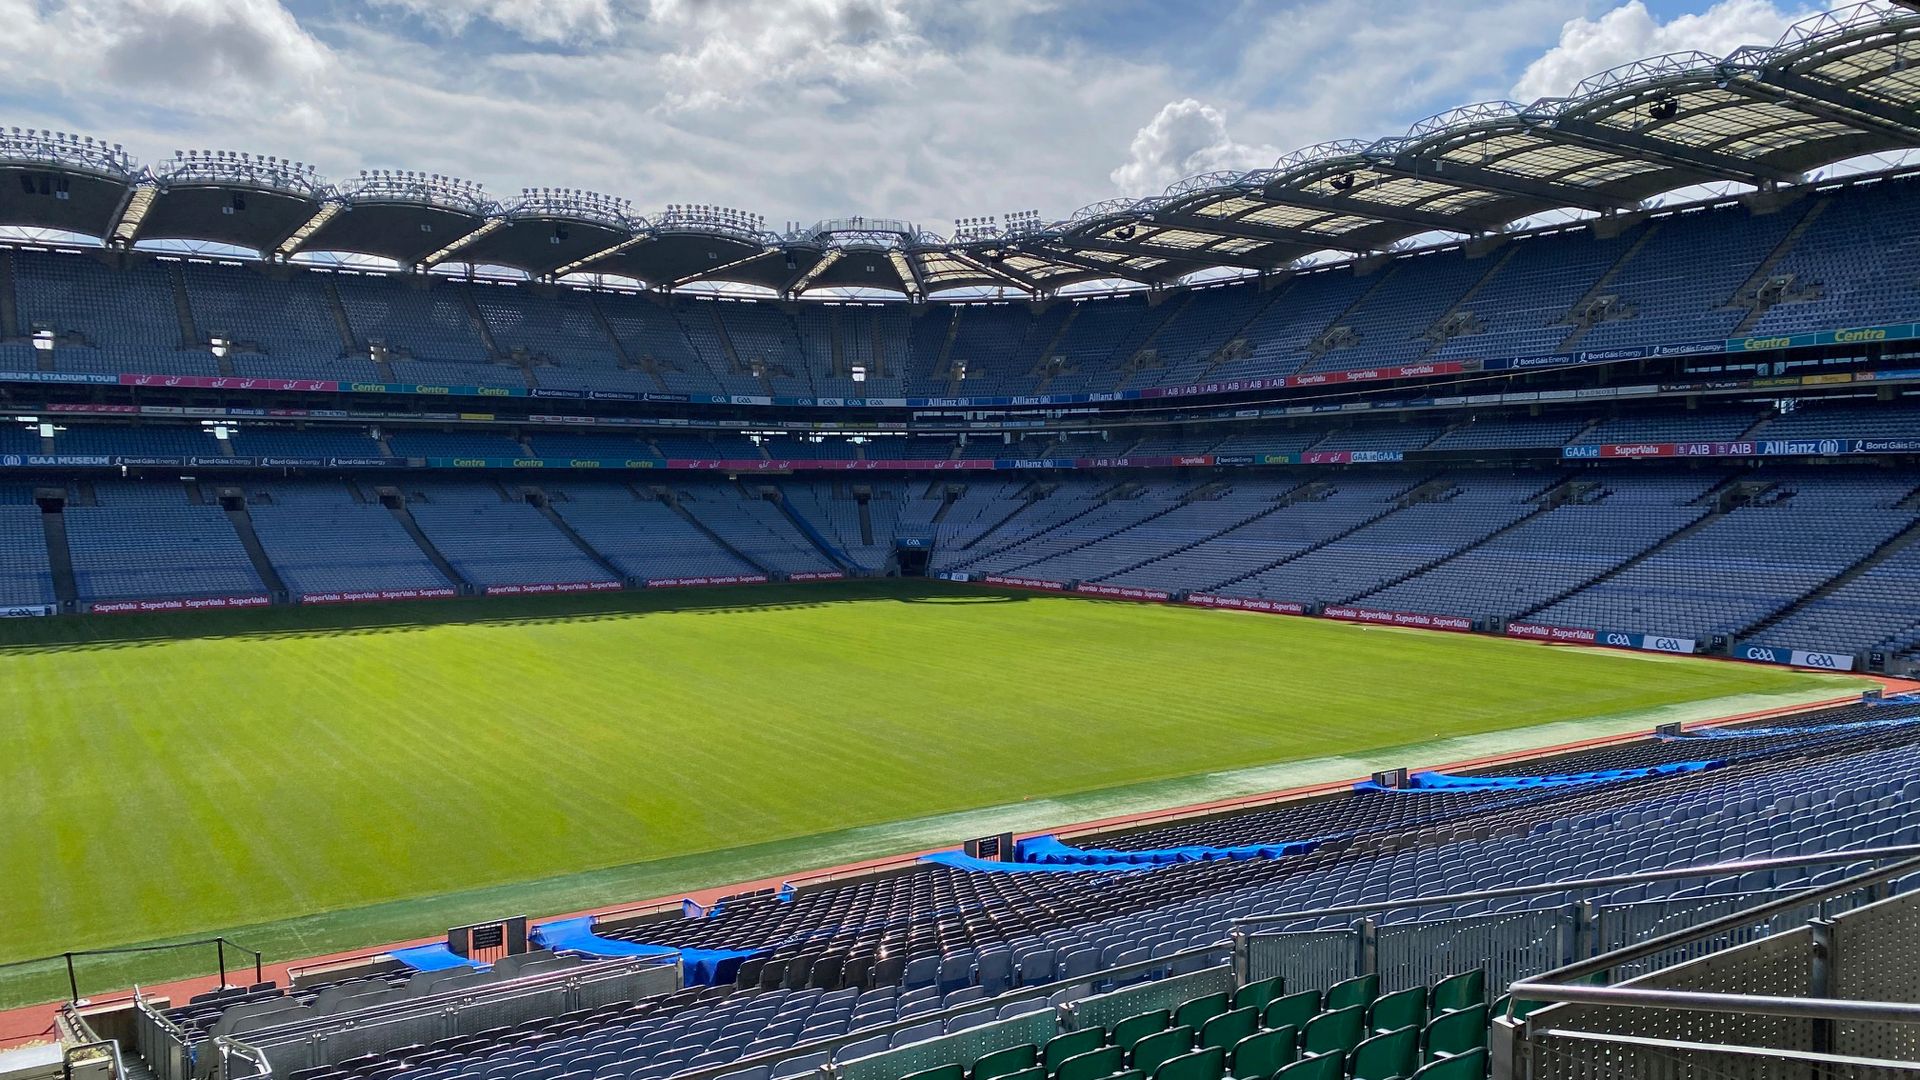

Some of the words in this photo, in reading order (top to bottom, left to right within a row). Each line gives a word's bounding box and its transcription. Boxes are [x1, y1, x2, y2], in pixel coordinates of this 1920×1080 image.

[1834, 329, 1886, 342] Centra
[1662, 346, 1678, 354] Bord
[1695, 343, 1721, 352] Energy
[1744, 337, 1790, 350] Centra
[1549, 356, 1570, 364] Energy
[1588, 352, 1604, 360] Bord
[1619, 350, 1642, 358] Energy
[1347, 370, 1378, 380] SuperValu
[1401, 365, 1434, 376] SuperValu
[42, 373, 87, 382] STADIUM
[90, 374, 117, 383] TOUR
[1272, 378, 1285, 387] AIB
[1297, 375, 1326, 385] SuperValu
[351, 382, 386, 393] Centra
[415, 384, 449, 394] Centra
[1206, 384, 1218, 392] AIB
[1227, 382, 1239, 390] AIB
[1250, 380, 1262, 388] AIB
[477, 386, 509, 396] Centra
[1186, 386, 1197, 394] AIB
[927, 398, 957, 407] Allianz
[1011, 396, 1039, 405] Allianz
[1089, 393, 1113, 402] Allianz
[1615, 445, 1658, 456] SuperValu
[1689, 444, 1710, 455] AIB
[1730, 443, 1752, 454] AIB
[1764, 441, 1816, 454] Allianz
[1866, 442, 1888, 450] Bord
[1352, 451, 1377, 461] GAA.ie
[1378, 451, 1403, 461] GAA.ie
[1565, 447, 1598, 457] GAA.ie
[30, 456, 56, 465] GAA
[58, 456, 109, 465] MUSEUM
[453, 458, 486, 467] Centra
[513, 459, 544, 467] Centra
[570, 459, 599, 468] Centra
[625, 459, 654, 468] Centra
[1014, 459, 1042, 469] Allianz
[1097, 459, 1108, 467] AIB
[1264, 455, 1289, 464] Centra
[487, 586, 521, 594] SuperValu
[523, 584, 555, 592] SuperValu
[557, 583, 588, 591] SuperValu
[590, 581, 621, 589] SuperValu
[304, 594, 340, 603] SuperValu
[343, 592, 379, 601] SuperValu
[382, 590, 417, 599] SuperValu
[419, 588, 454, 597] SuperValu
[94, 602, 137, 612] SuperValu
[140, 600, 182, 610] SuperValu
[185, 599, 226, 608] SuperValu
[229, 597, 268, 606] SuperValu
[1324, 607, 1356, 618] SuperValu
[1359, 610, 1393, 621] SuperValu
[1395, 613, 1430, 624] SuperValu
[1432, 616, 1470, 628] SuperValu
[1509, 623, 1549, 636] SuperValu
[1552, 628, 1595, 640] SuperValu
[1607, 633, 1631, 646] GAA
[1655, 638, 1680, 651] GAA
[1747, 647, 1776, 662] GAA
[1806, 653, 1836, 668] GAA
